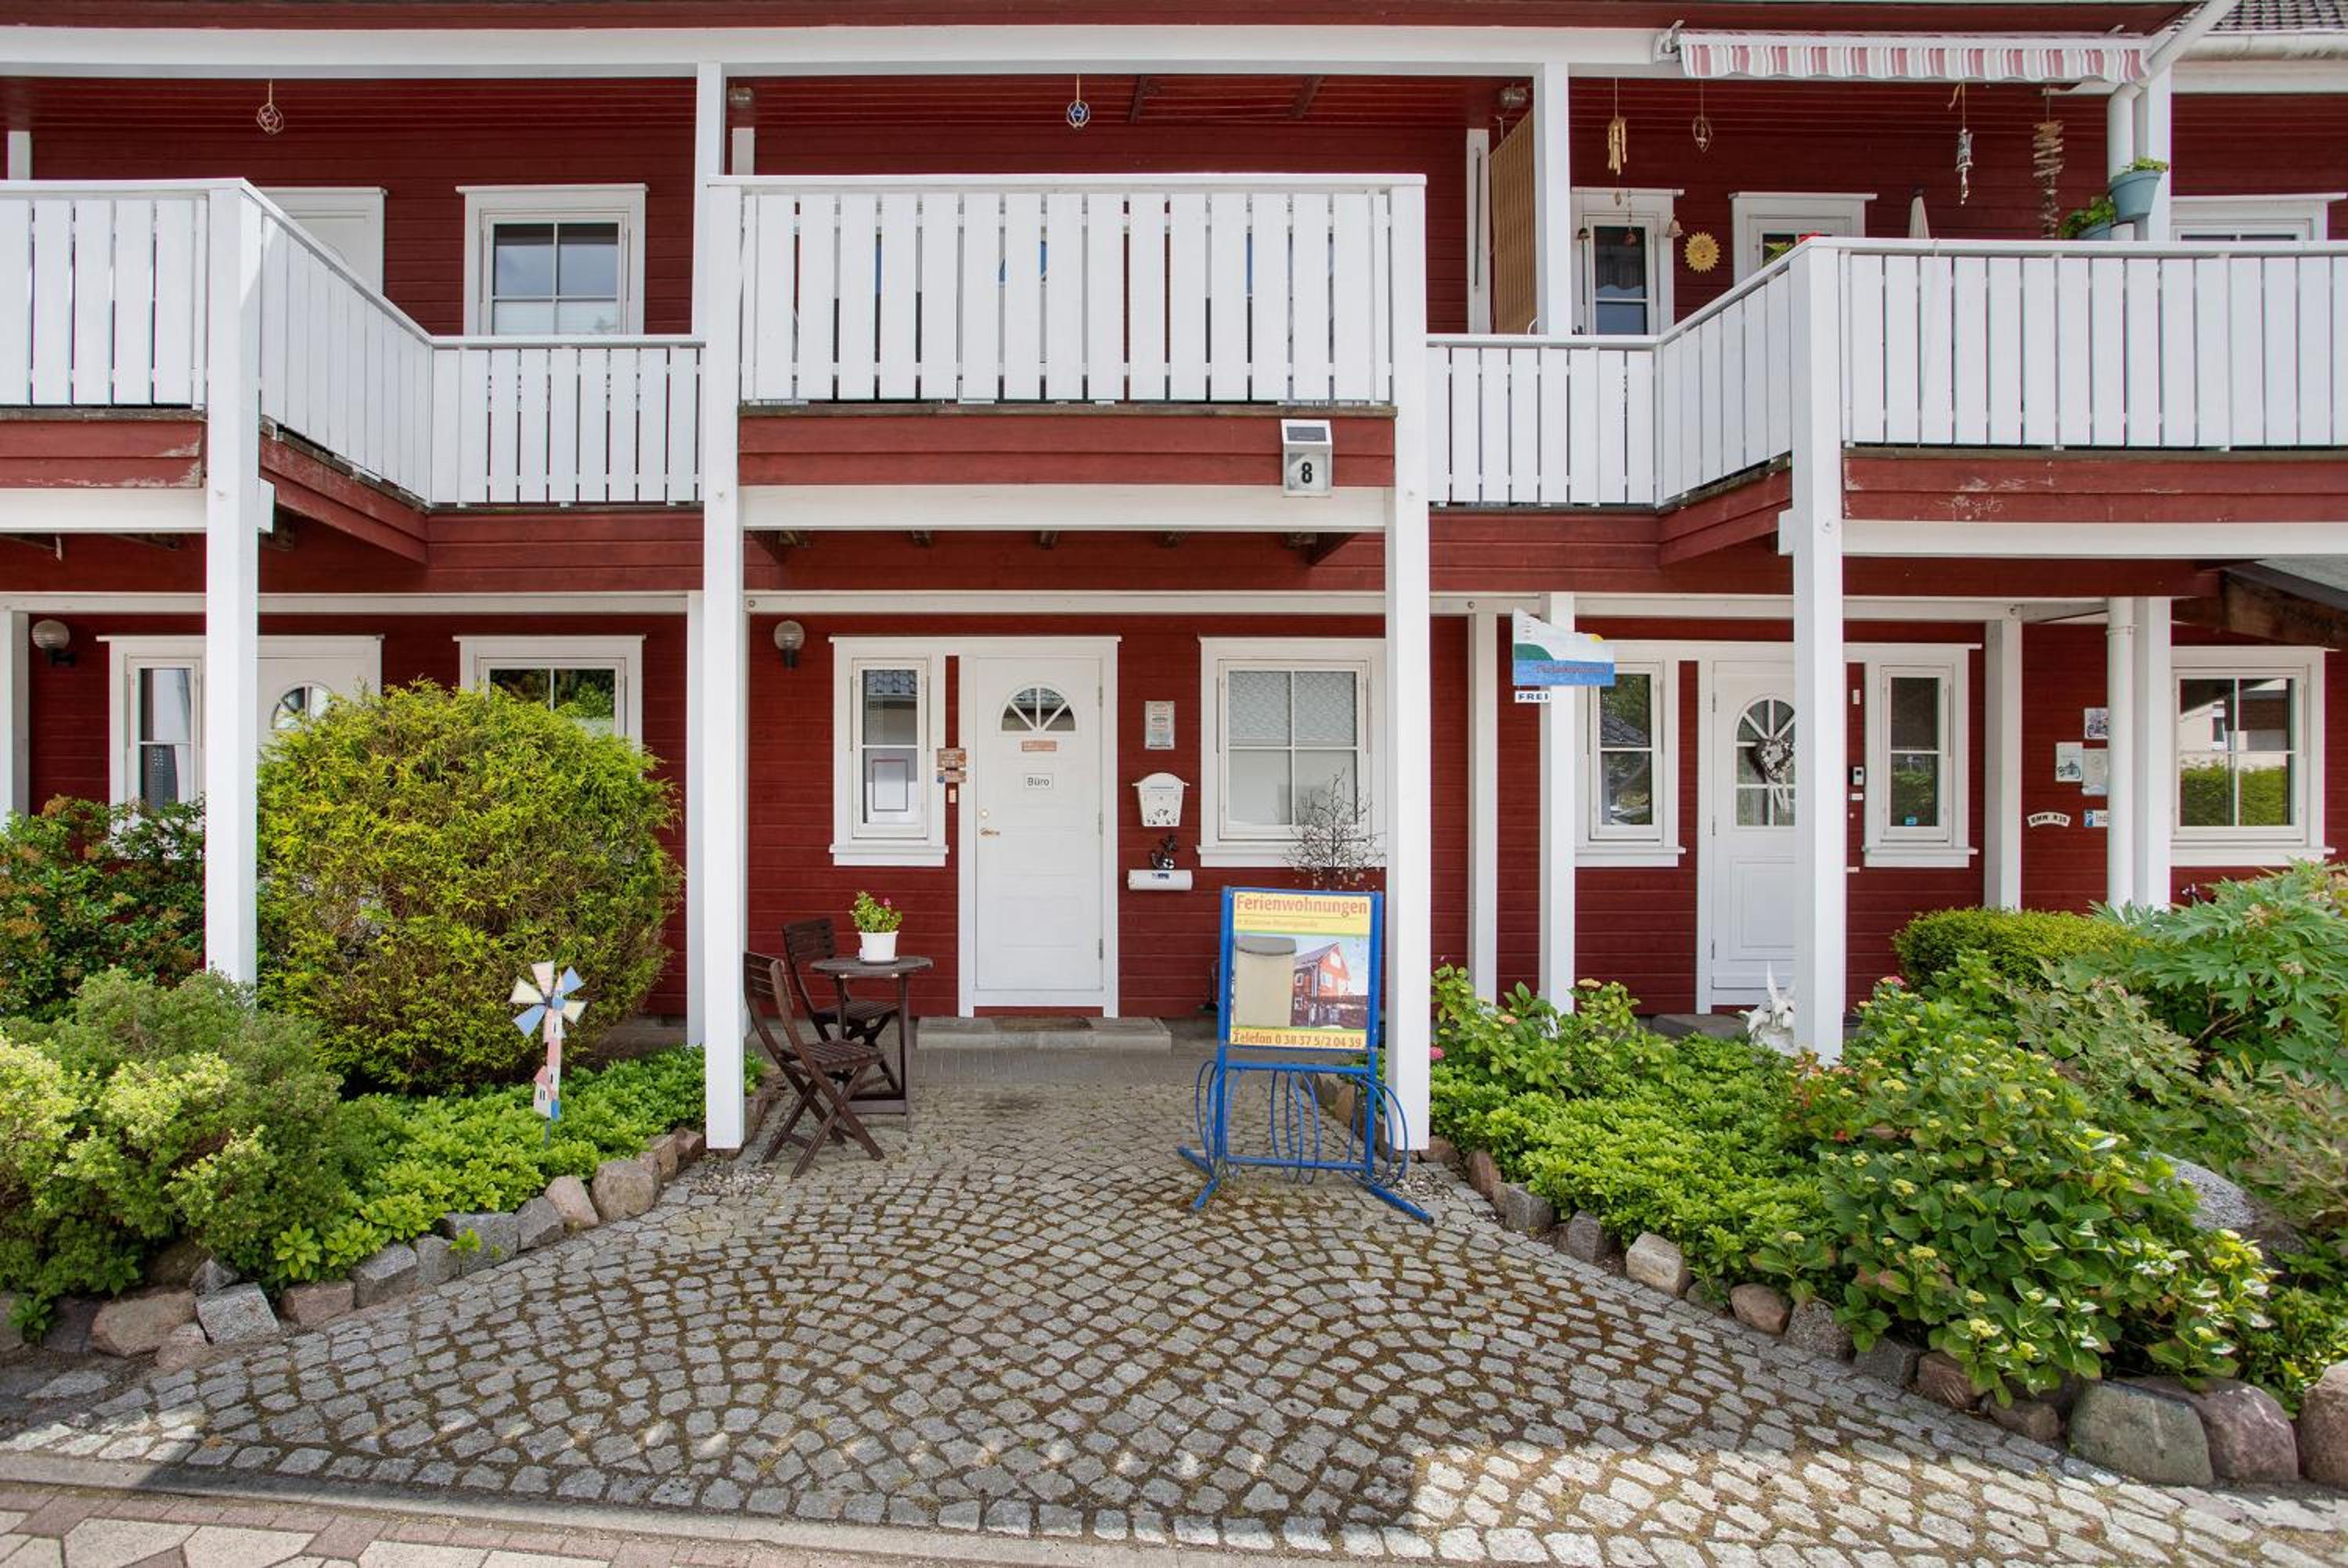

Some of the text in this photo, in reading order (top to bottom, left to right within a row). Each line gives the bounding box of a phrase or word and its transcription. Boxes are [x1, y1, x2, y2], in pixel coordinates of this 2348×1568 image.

[1302, 462, 1313, 484] 8
[1518, 692, 1549, 701] FREI
[1027, 776, 1050, 787] Büro
[1237, 895, 1367, 918] Ferienwohnungen
[1233, 1030, 1272, 1044] Telefon
